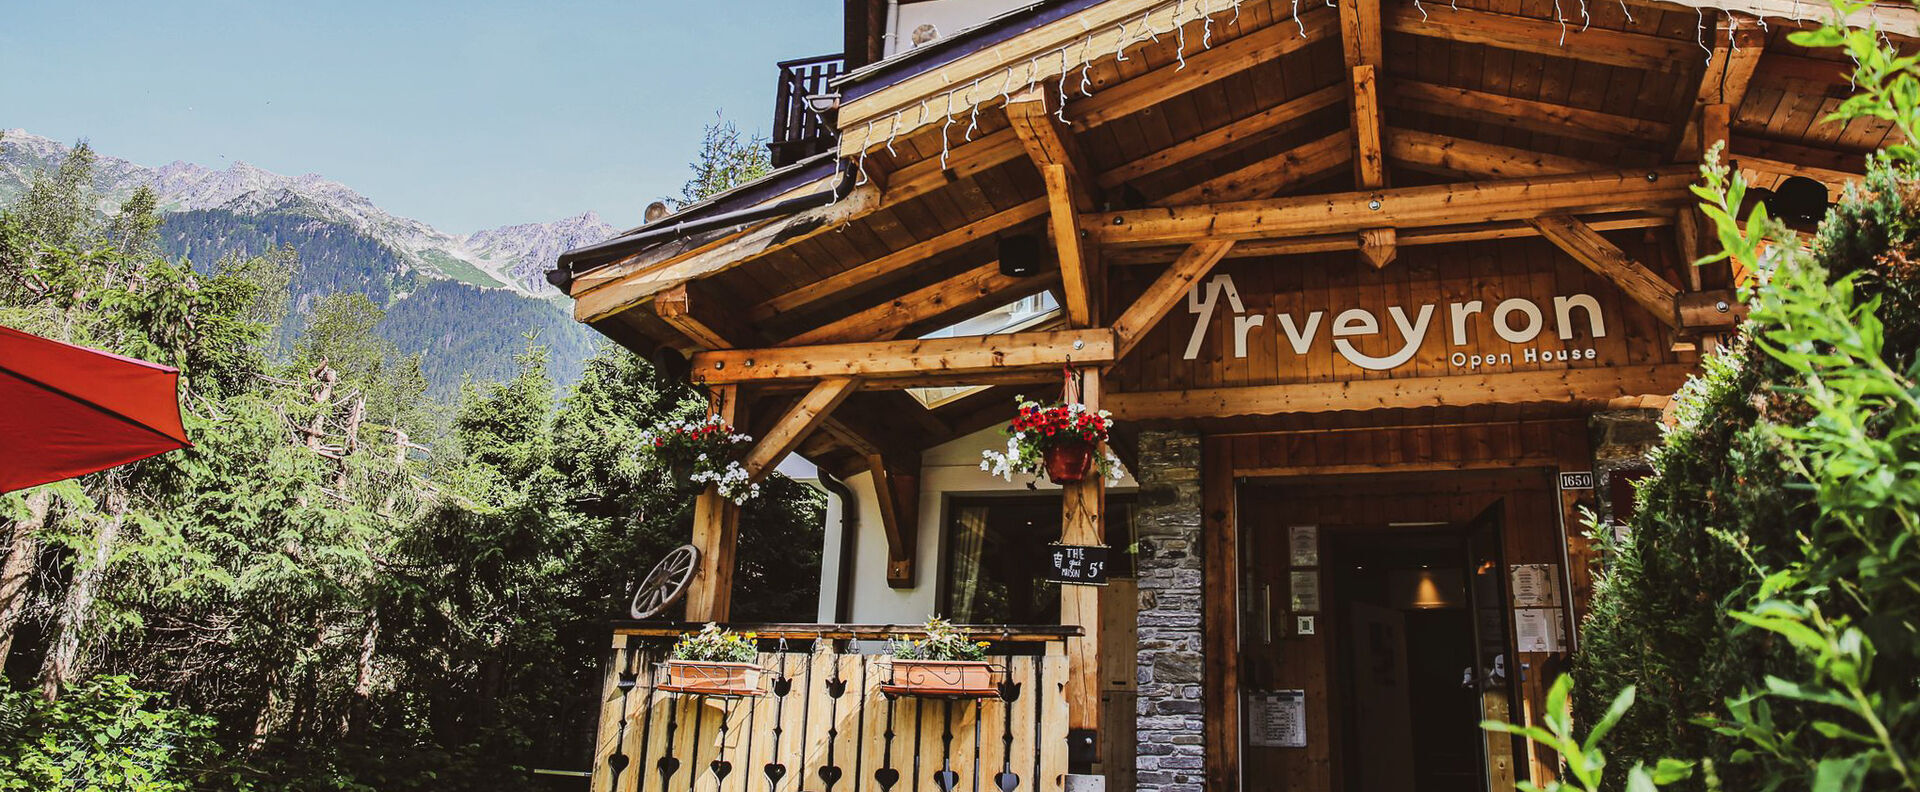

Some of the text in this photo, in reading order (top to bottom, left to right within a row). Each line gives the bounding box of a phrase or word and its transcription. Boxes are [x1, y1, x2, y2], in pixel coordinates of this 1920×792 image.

[1451, 347, 1597, 369] Open House
[1563, 475, 1590, 487] 1650
[1061, 568, 1081, 578] MAISON
